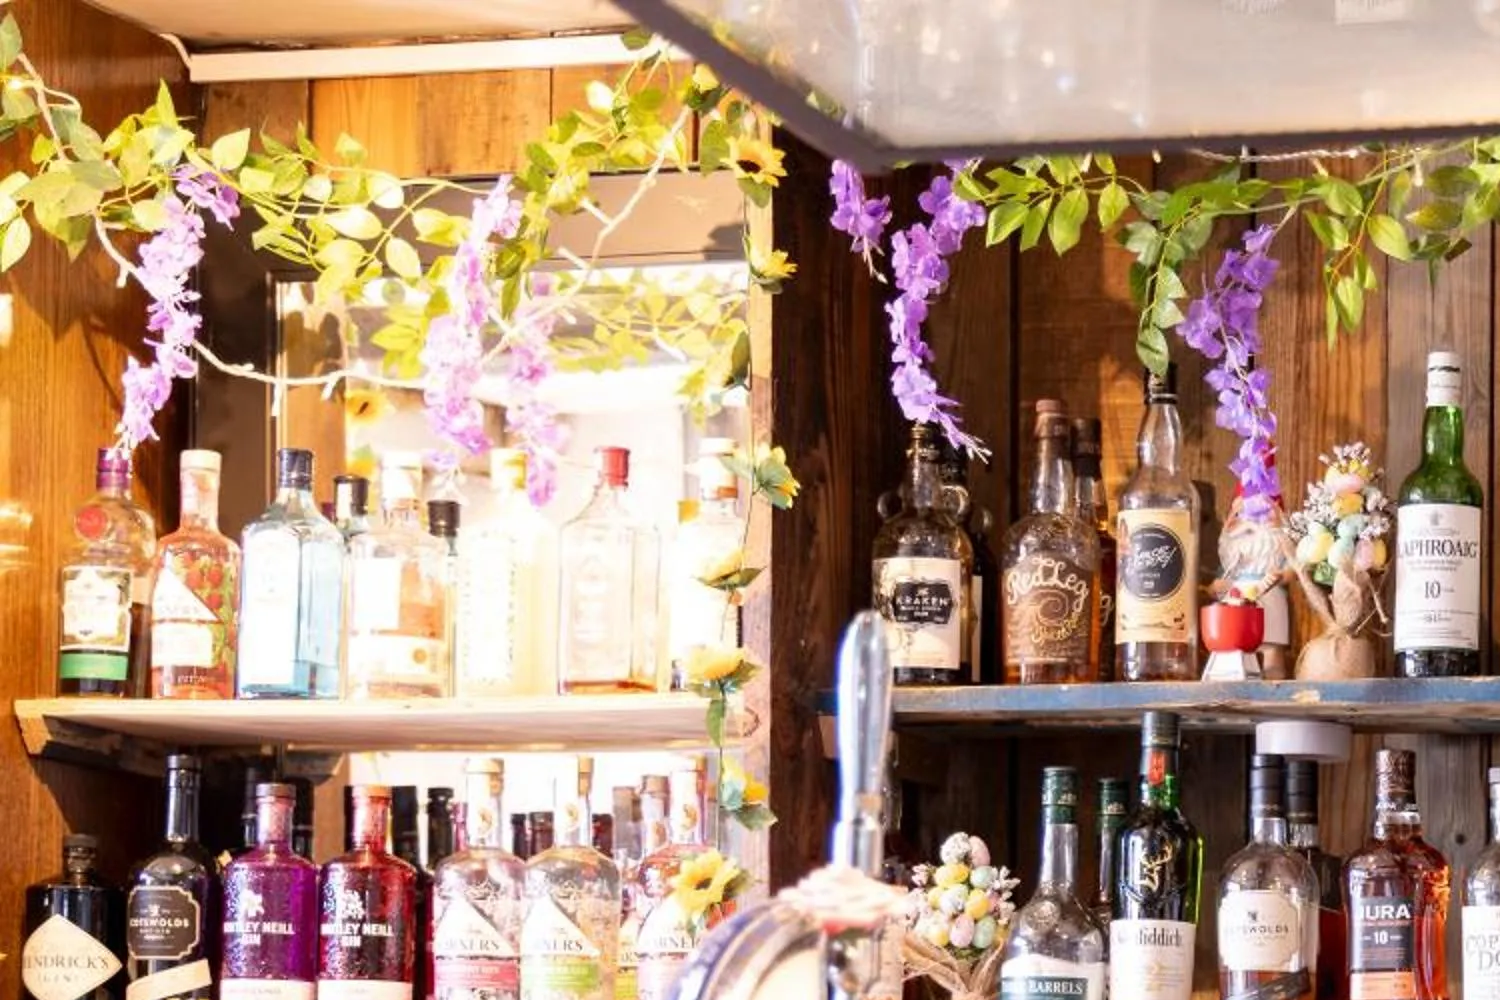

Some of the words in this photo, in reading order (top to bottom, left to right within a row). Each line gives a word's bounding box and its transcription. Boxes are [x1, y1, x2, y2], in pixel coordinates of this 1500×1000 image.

[1424, 580, 1441, 599] 10
[1373, 931, 1389, 945] 10
[1029, 981, 1083, 995] BARRELS
